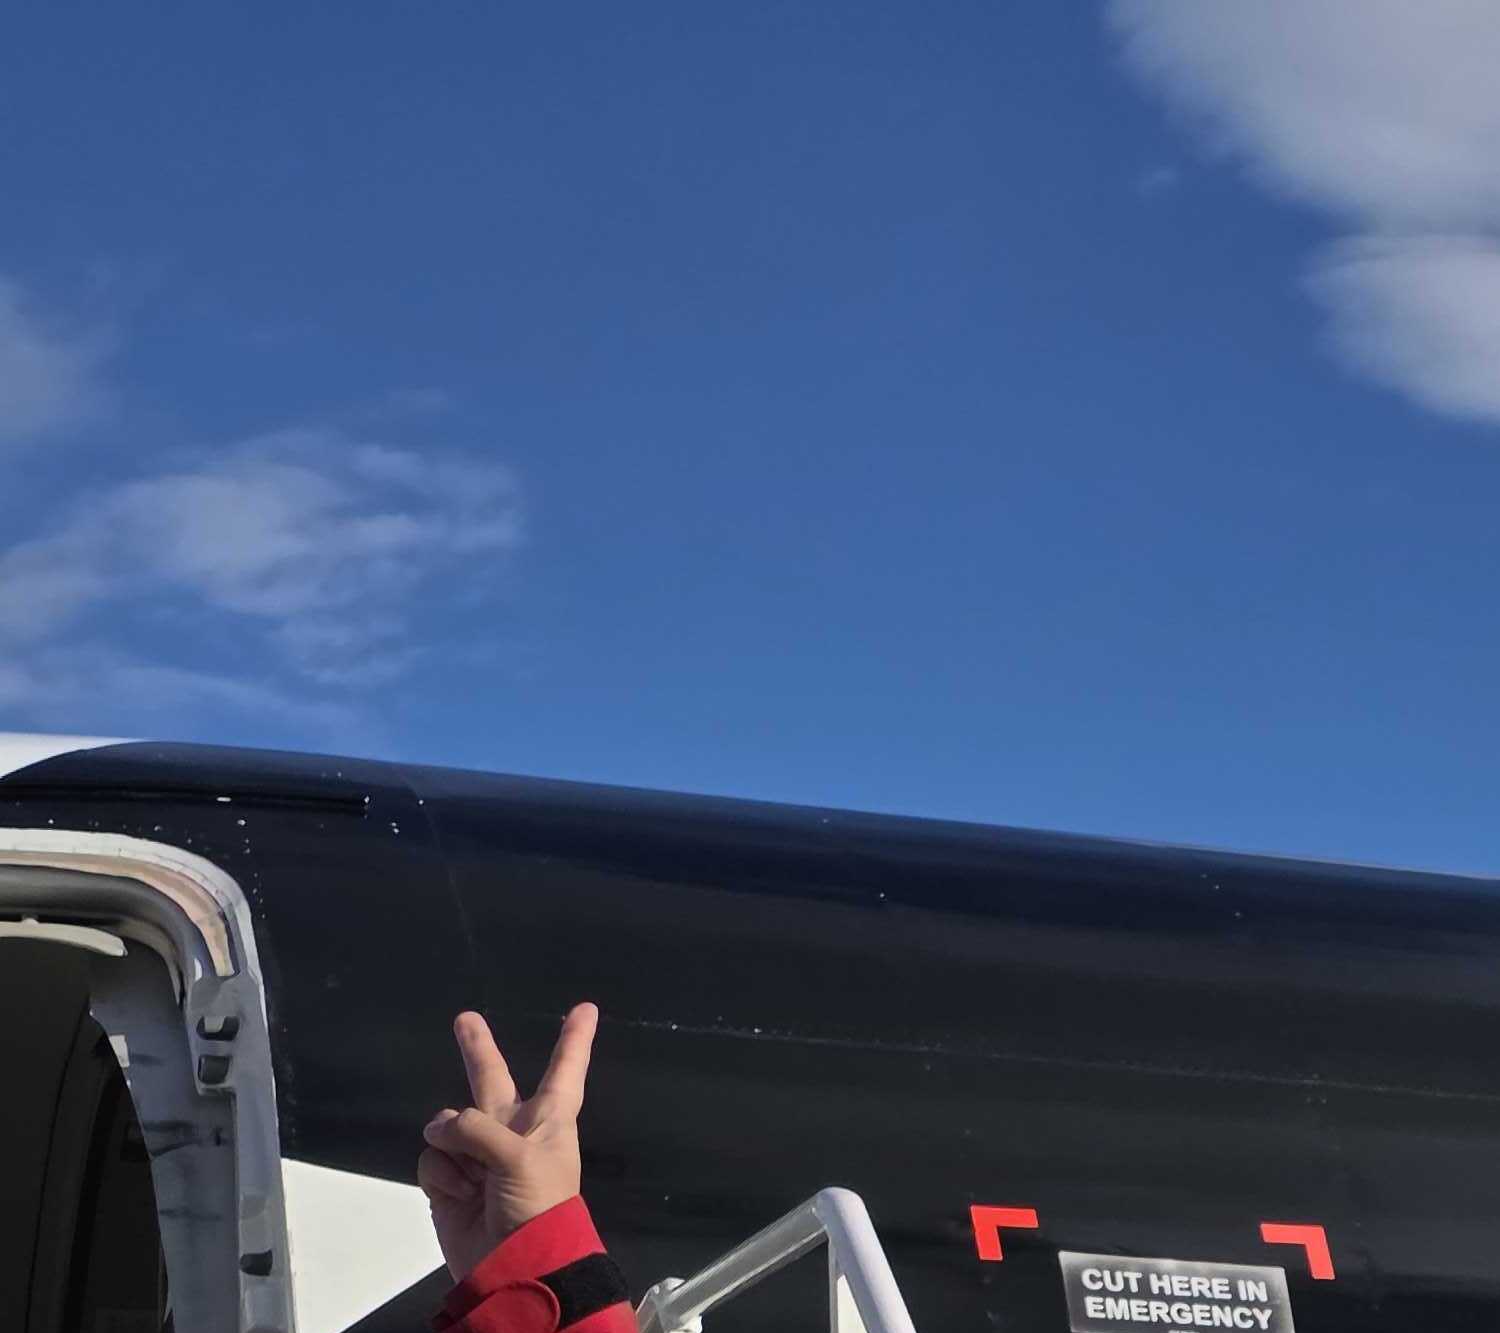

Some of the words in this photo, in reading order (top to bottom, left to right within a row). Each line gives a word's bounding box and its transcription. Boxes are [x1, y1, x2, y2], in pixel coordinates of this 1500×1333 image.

[1081, 1268, 1143, 1293] CUT
[1149, 1273, 1232, 1300] HERE
[1237, 1279, 1268, 1302] IN
[1084, 1296, 1273, 1330] EMERGENCY
